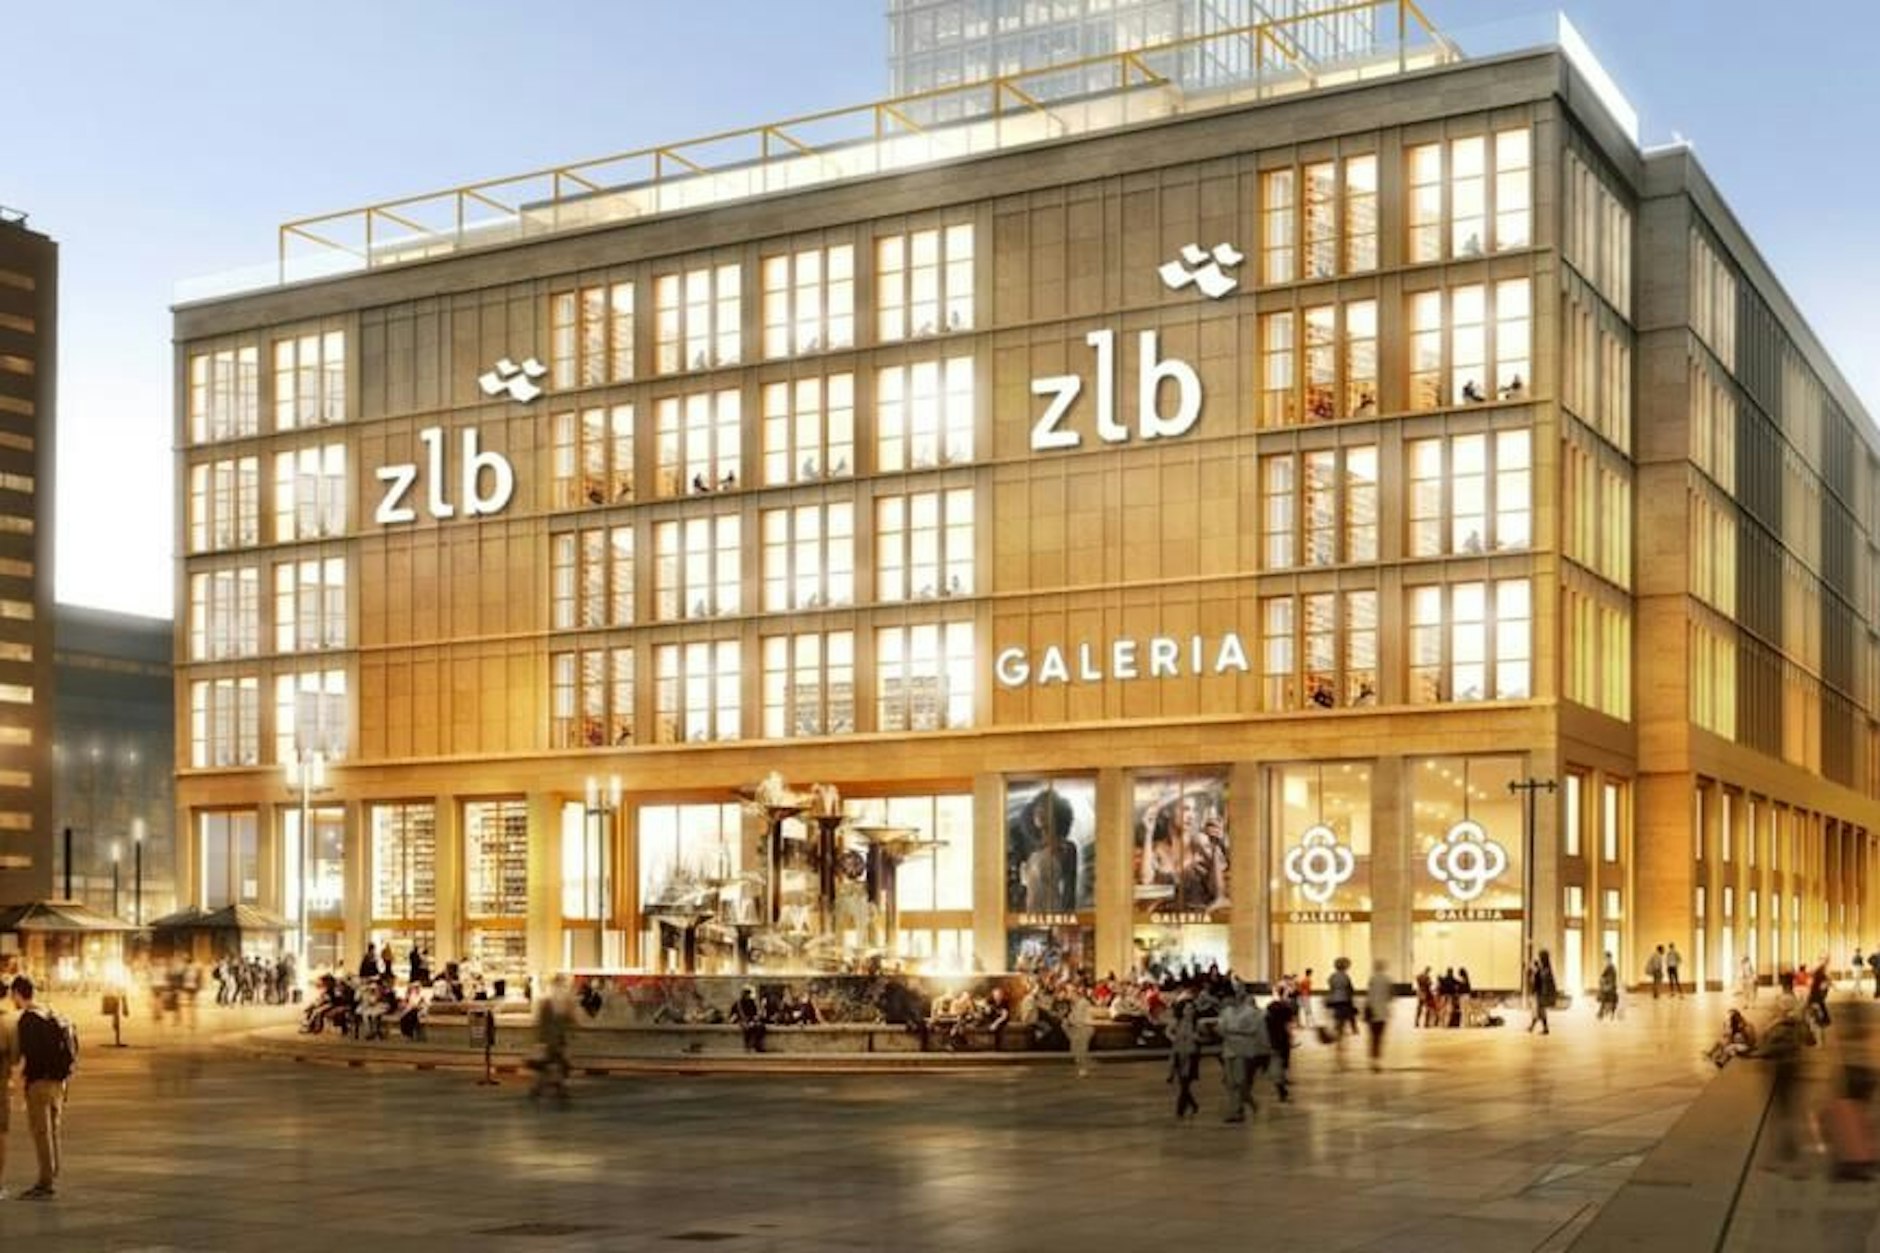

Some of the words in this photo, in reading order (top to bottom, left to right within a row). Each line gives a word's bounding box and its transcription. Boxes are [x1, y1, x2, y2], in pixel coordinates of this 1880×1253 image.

[1030, 328, 1202, 450] zlb
[375, 425, 515, 524] zlb
[995, 632, 1249, 687] GALERIA
[1017, 912, 1079, 926] GALERIA
[1149, 911, 1213, 925] GALERIA
[1289, 911, 1352, 924] GALERIA
[1434, 909, 1504, 921] GALERIA
